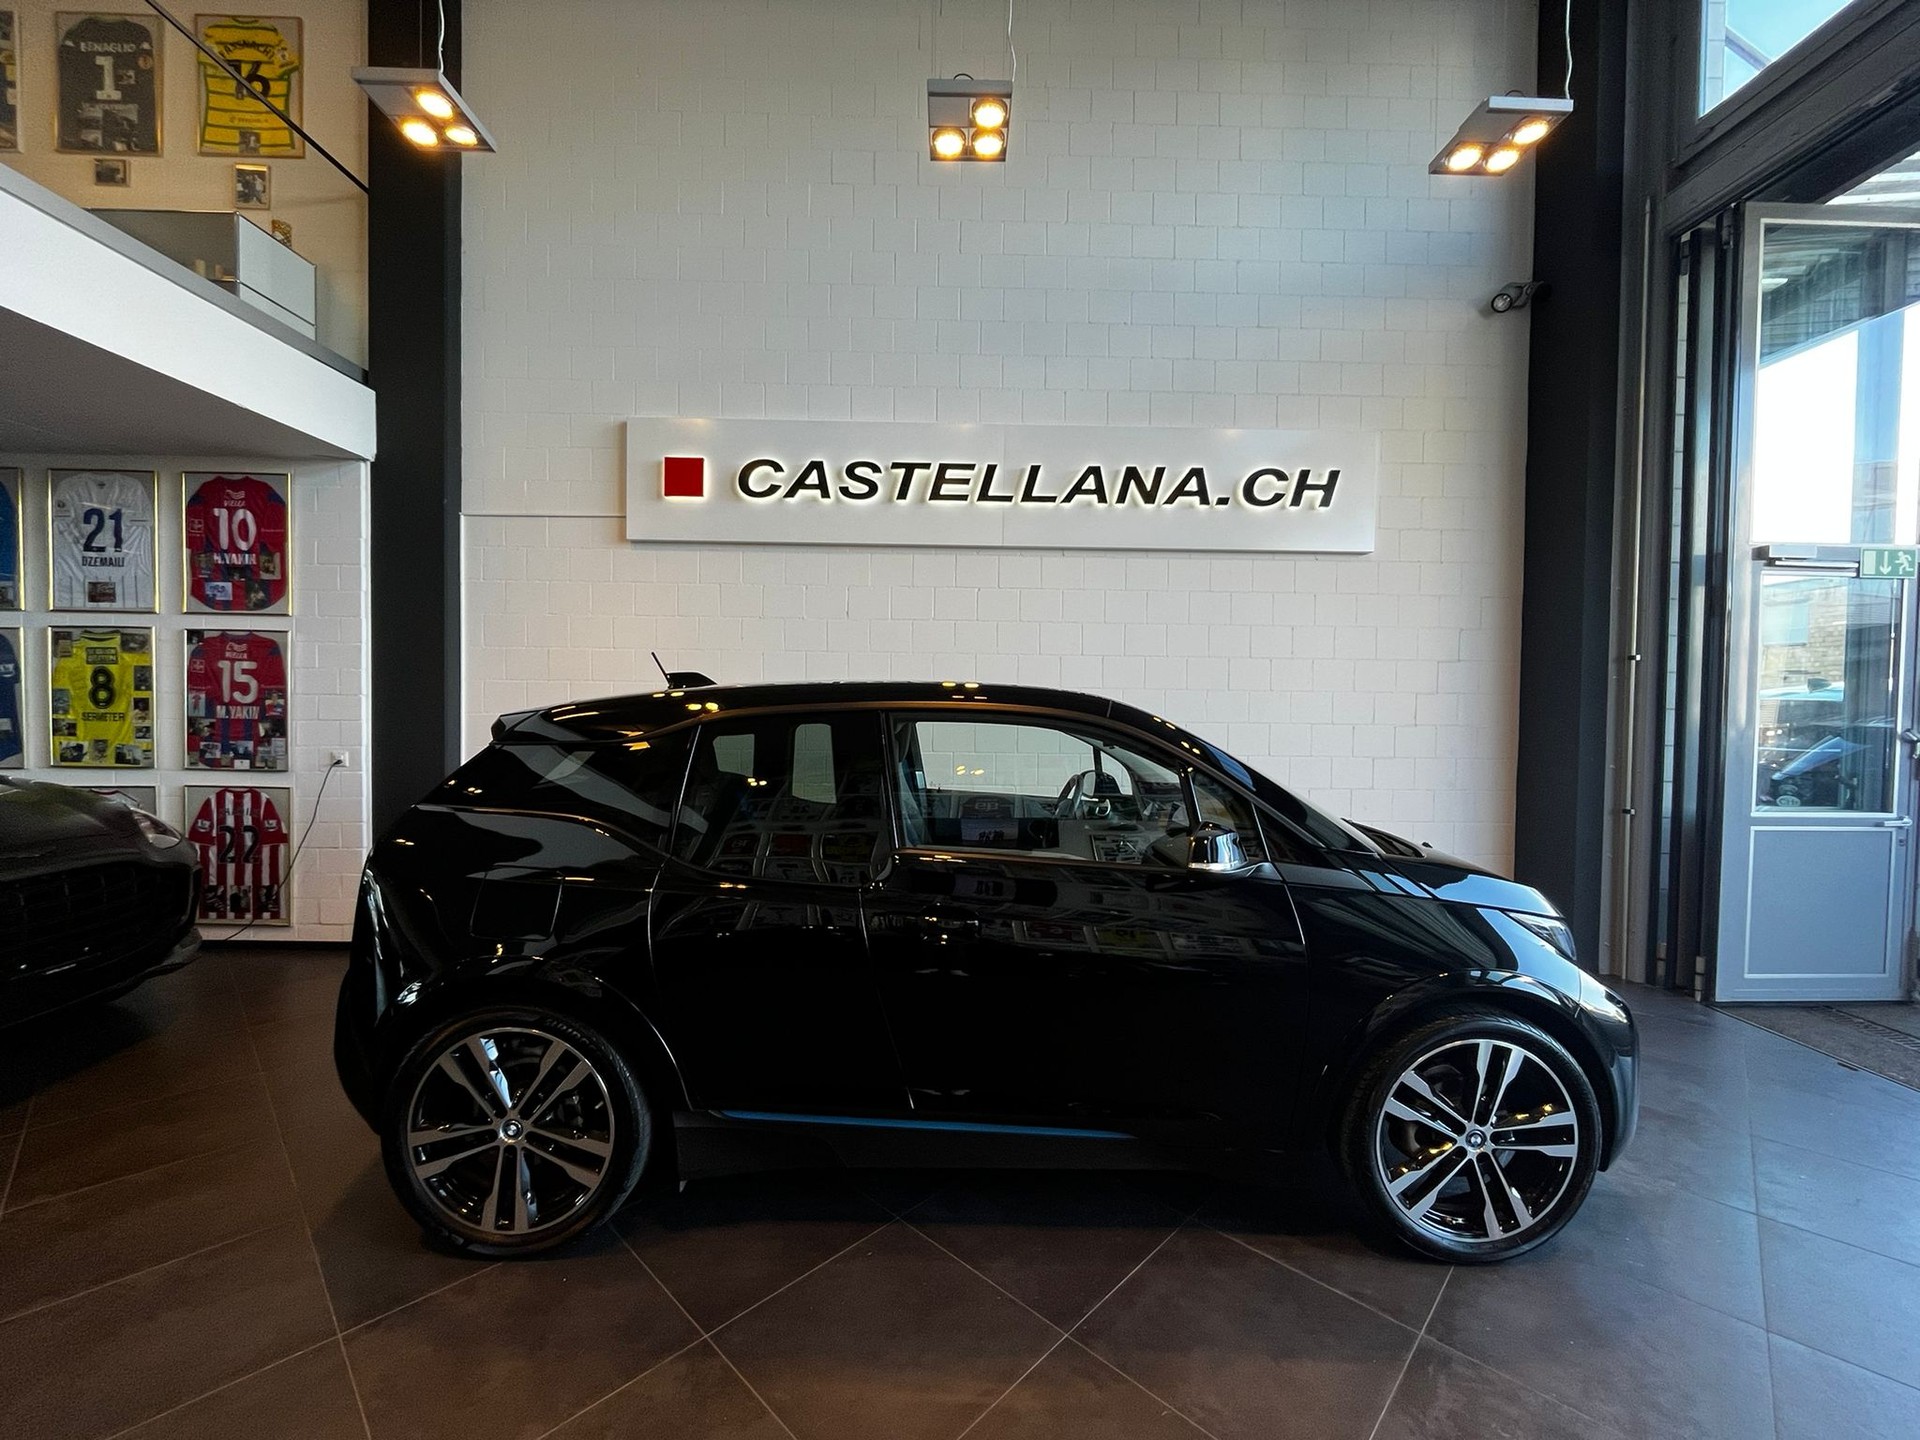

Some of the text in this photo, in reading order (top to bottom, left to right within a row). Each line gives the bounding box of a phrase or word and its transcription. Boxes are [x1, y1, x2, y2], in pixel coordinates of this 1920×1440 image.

[95, 55, 122, 100] 1
[737, 458, 1341, 509] CASTELLANA.CH
[82, 507, 124, 553] 21
[213, 508, 257, 551] 10
[81, 556, 125, 567] DZEMAILI
[88, 665, 117, 710] 8
[217, 660, 259, 704] 15
[217, 825, 260, 864] 22
